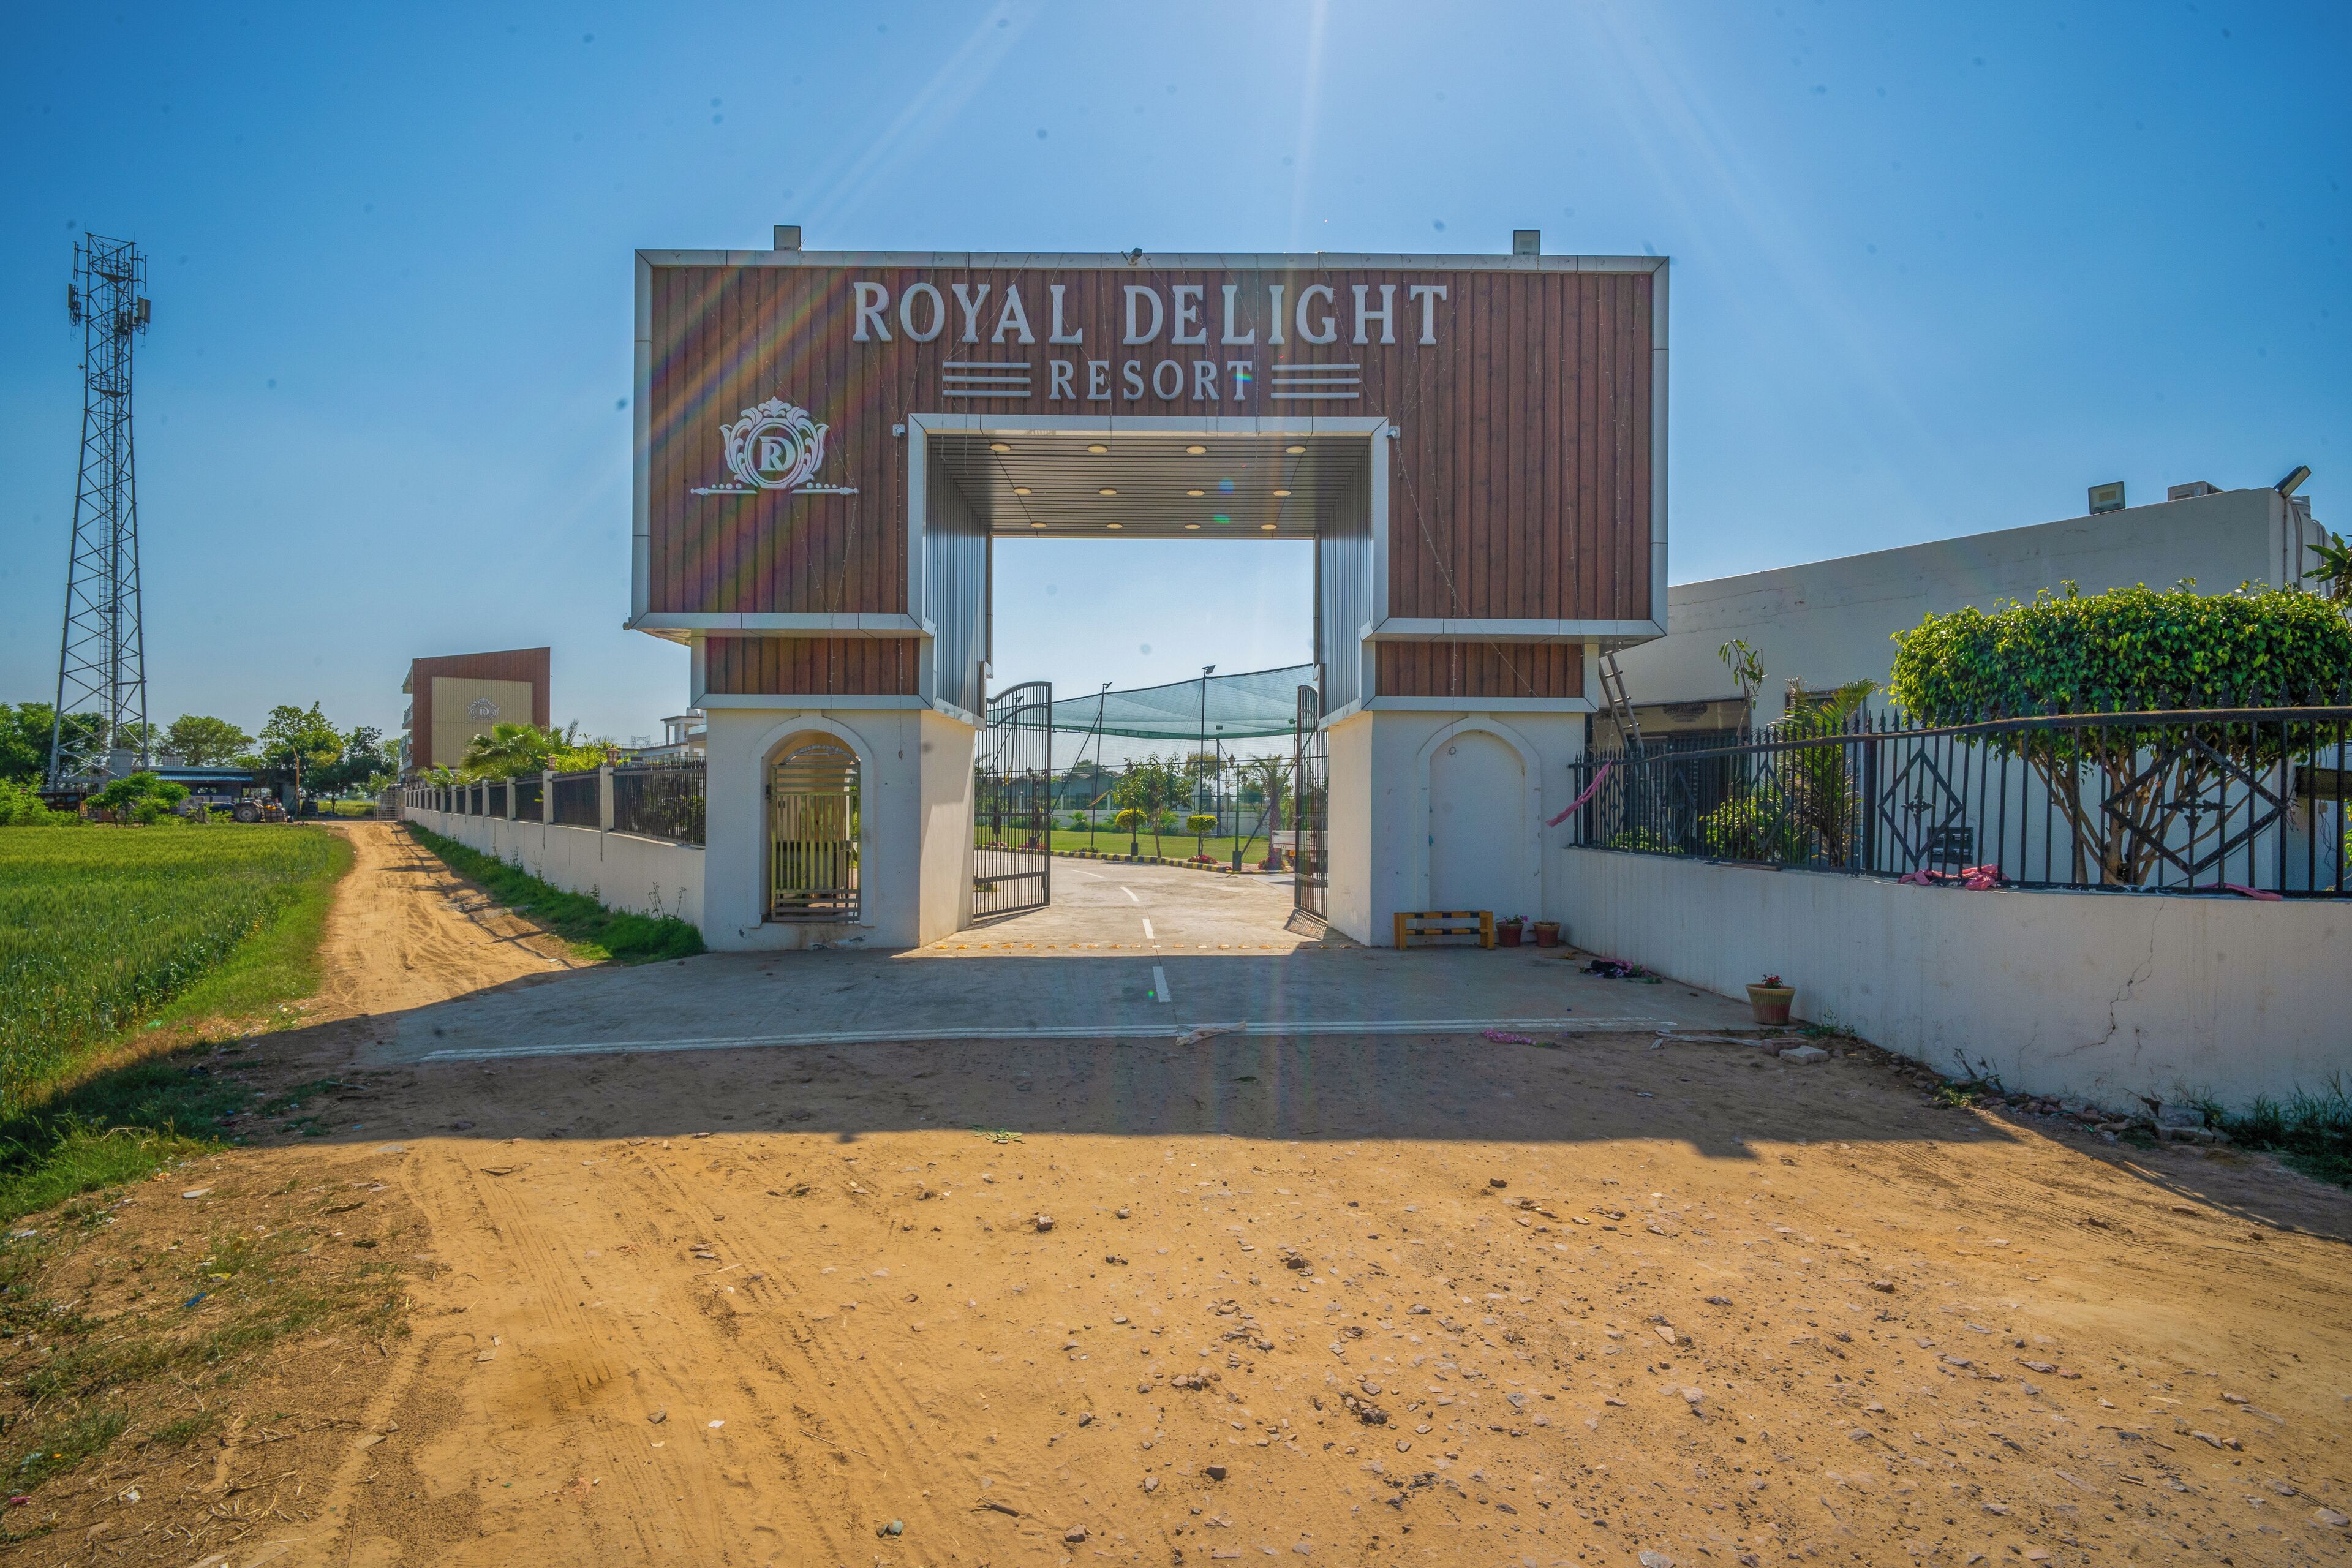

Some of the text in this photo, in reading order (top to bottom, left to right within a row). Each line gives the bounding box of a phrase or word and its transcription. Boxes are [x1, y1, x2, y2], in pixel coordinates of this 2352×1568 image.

[852, 282, 1447, 346] ROYAL DELIGHT
[1049, 360, 1253, 402] RESORT
